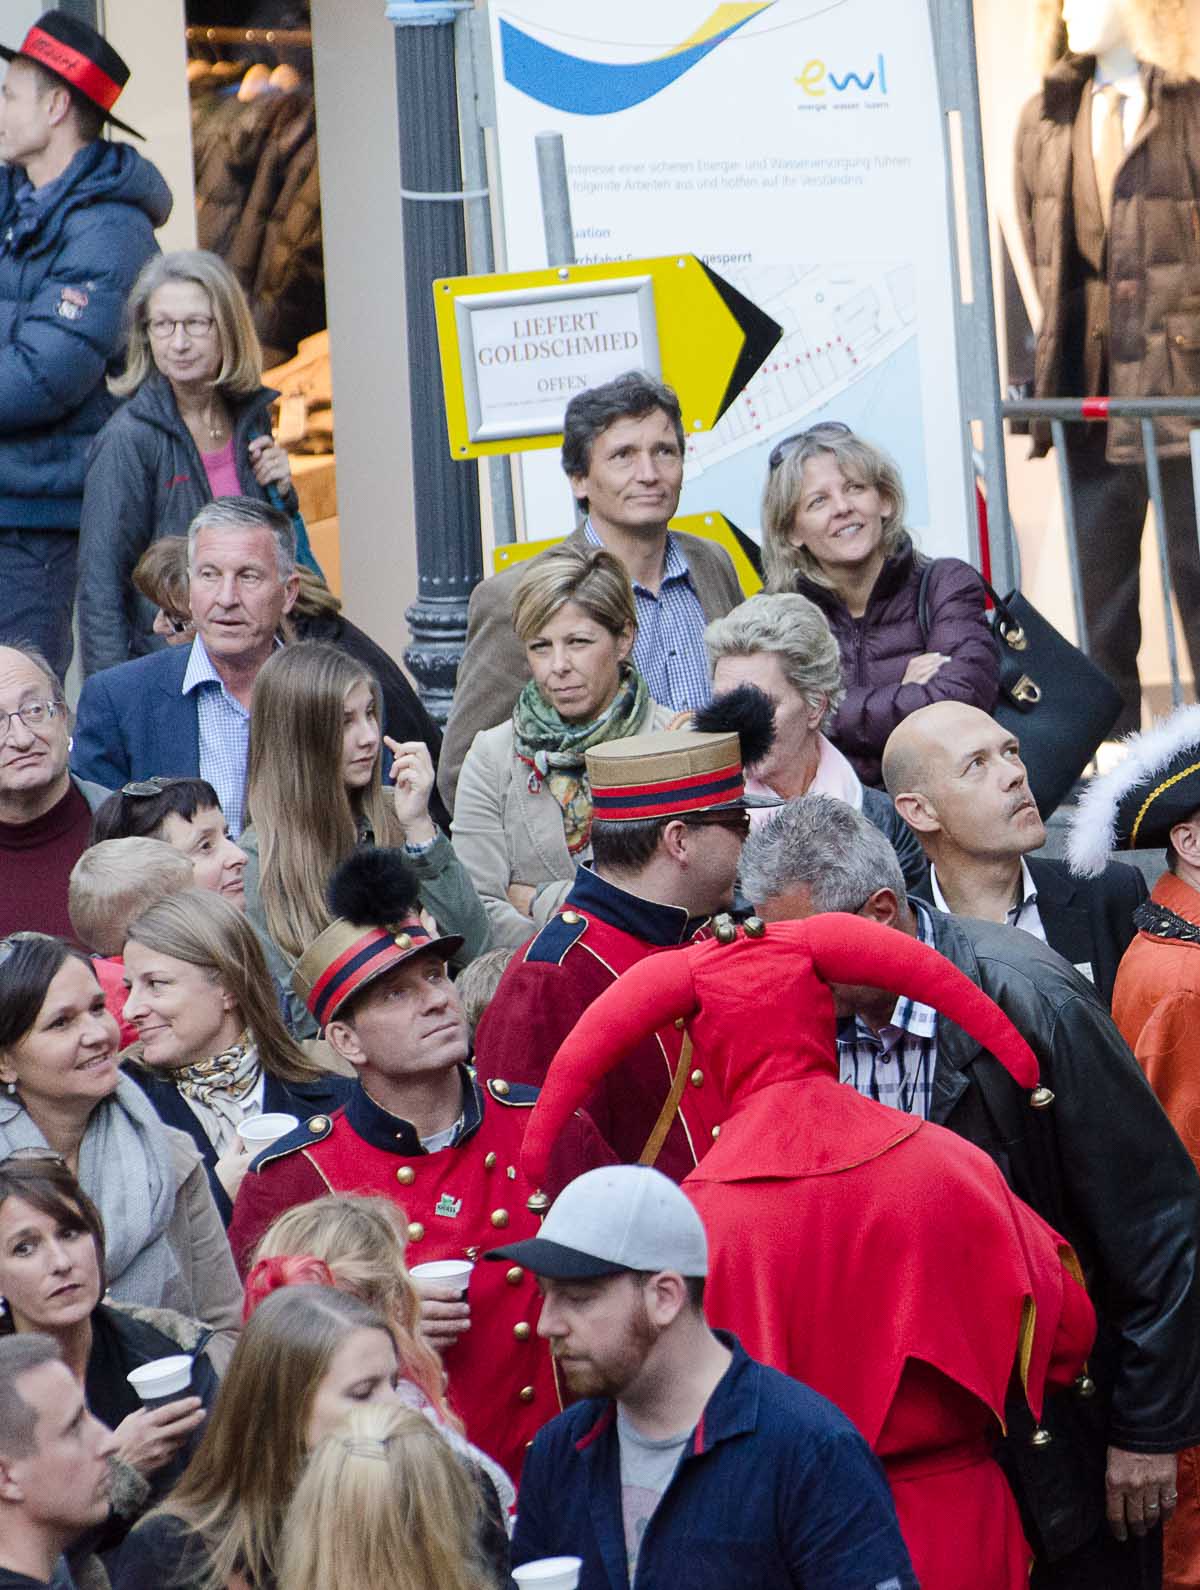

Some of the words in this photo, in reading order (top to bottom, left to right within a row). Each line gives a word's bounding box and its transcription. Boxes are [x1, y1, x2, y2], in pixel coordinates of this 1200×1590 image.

[794, 52, 888, 96] ewl
[573, 226, 611, 239] uation
[702, 252, 753, 266] gesperrt
[513, 311, 600, 339] LIEFERT
[478, 331, 639, 367] GOLDSCHMIED
[536, 374, 588, 393] OFFEN
